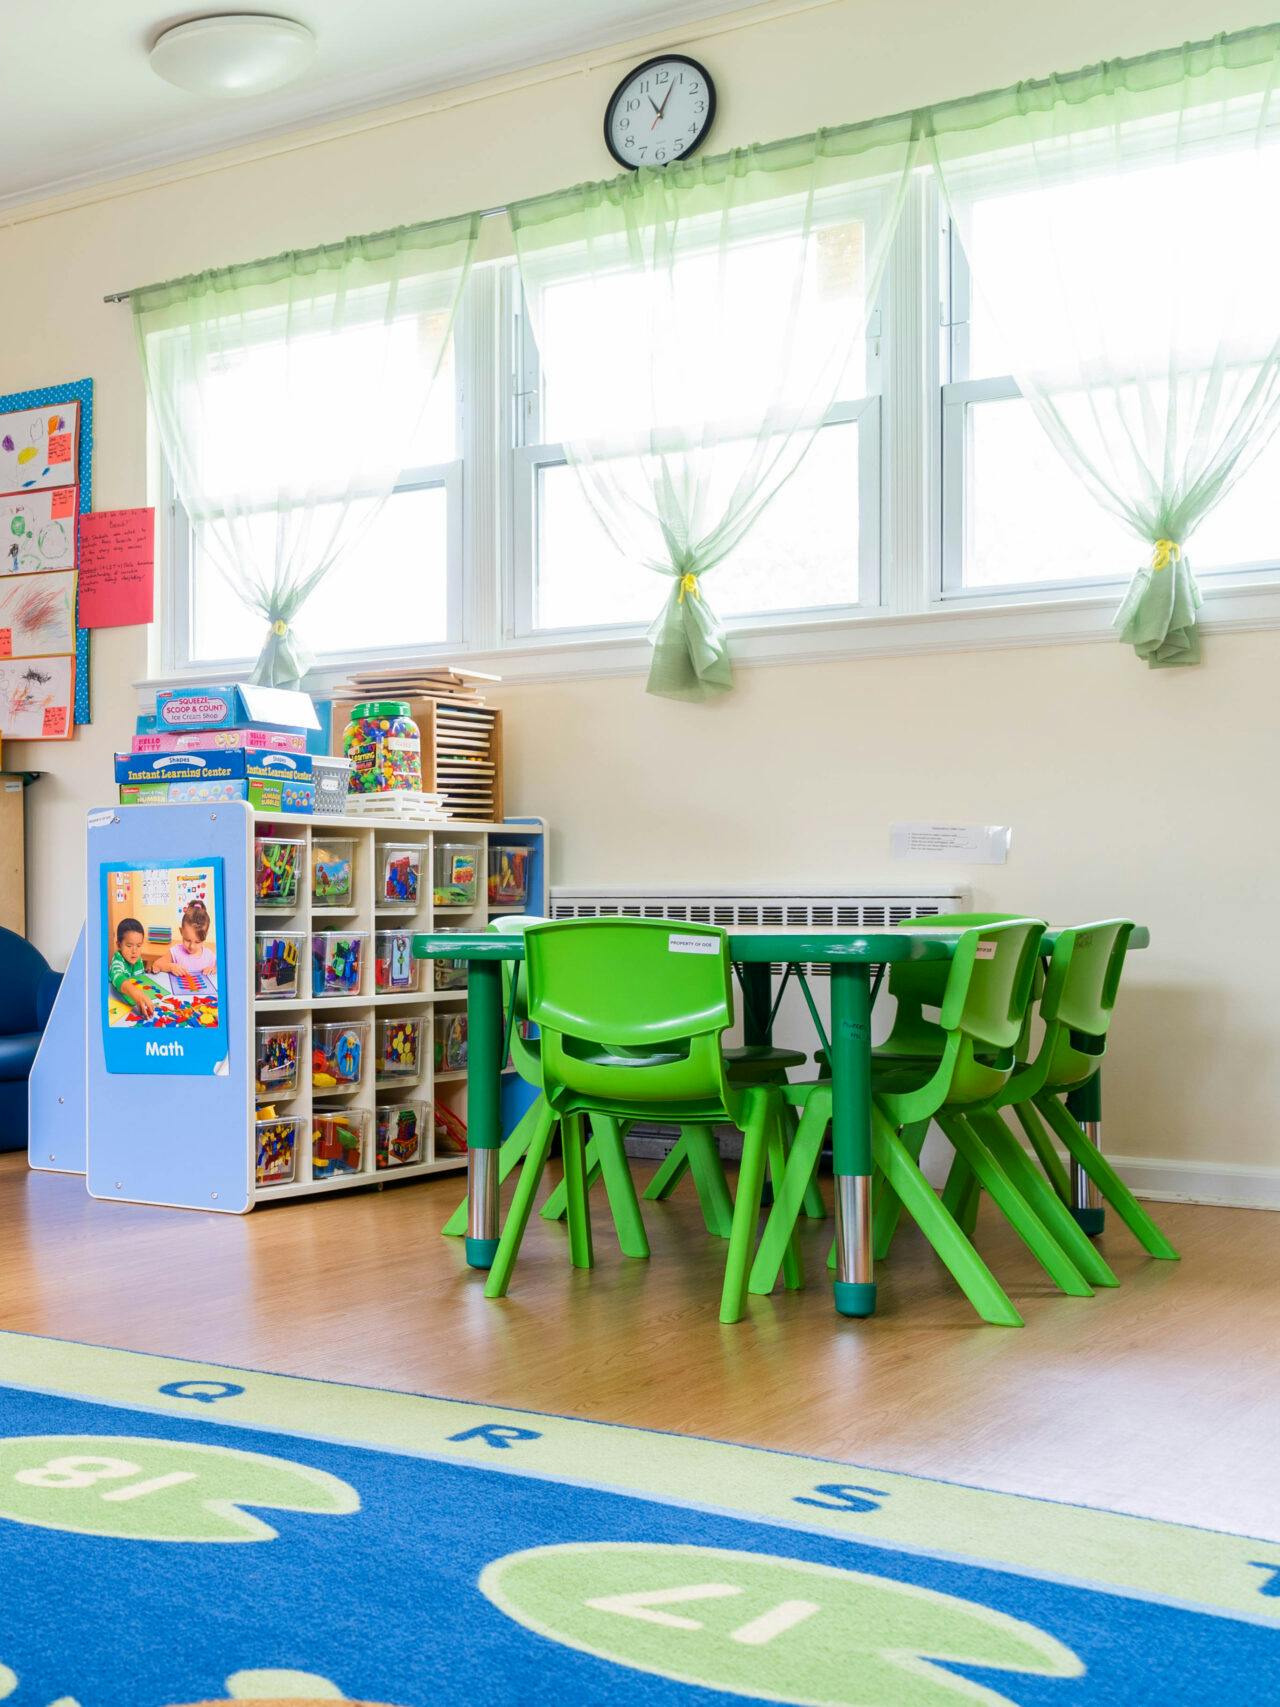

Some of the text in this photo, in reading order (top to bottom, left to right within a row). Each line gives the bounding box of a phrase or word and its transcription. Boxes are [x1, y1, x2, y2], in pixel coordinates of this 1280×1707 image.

[655, 71, 669, 85] 12
[640, 80, 649, 93] 11
[689, 82, 698, 95] 2
[626, 98, 640, 112] 10
[694, 100, 704, 113] 3
[620, 118, 630, 130] 9
[688, 122, 698, 134] 4
[624, 136, 635, 148] 8
[673, 138, 684, 152] 5
[638, 146, 648, 159] 7
[655, 147, 666, 160] 6
[179, 696, 208, 704] SQUEEZE
[166, 706, 190, 714] SCOOP
[198, 704, 224, 712] COUNT
[138, 744, 160, 752] KITTY
[128, 767, 232, 780] Instant Learning Center
[246, 764, 312, 780] Instant Learning Center
[146, 1040, 184, 1057] Math
[158, 1379, 246, 1404] Q
[445, 1421, 543, 1450] R
[791, 1481, 892, 1514] S
[14, 1455, 199, 1502] 18
[582, 1581, 822, 1645] 17
